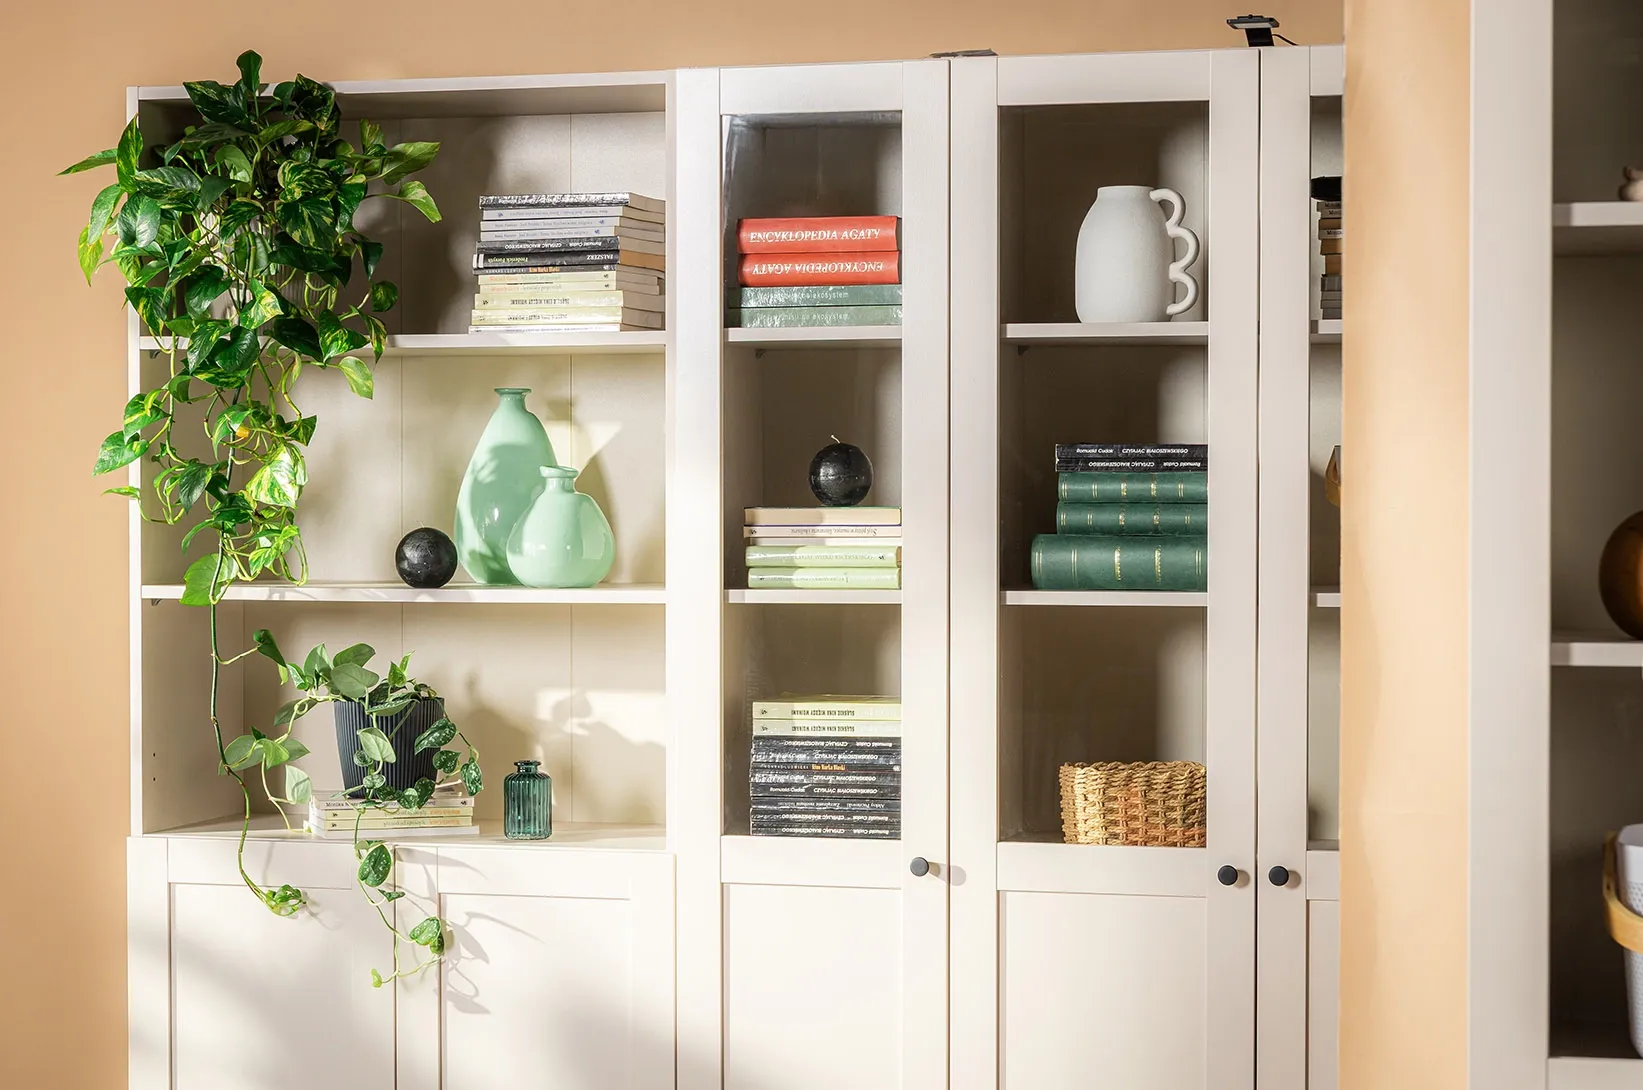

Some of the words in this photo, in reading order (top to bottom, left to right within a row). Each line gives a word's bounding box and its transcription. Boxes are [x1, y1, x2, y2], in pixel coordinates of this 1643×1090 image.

[749, 230, 838, 243] ENCYKLOPEDIA
[840, 228, 881, 240] AGATY
[752, 263, 793, 275] AGATY
[794, 262, 884, 274] ENCYKLOPEDIA
